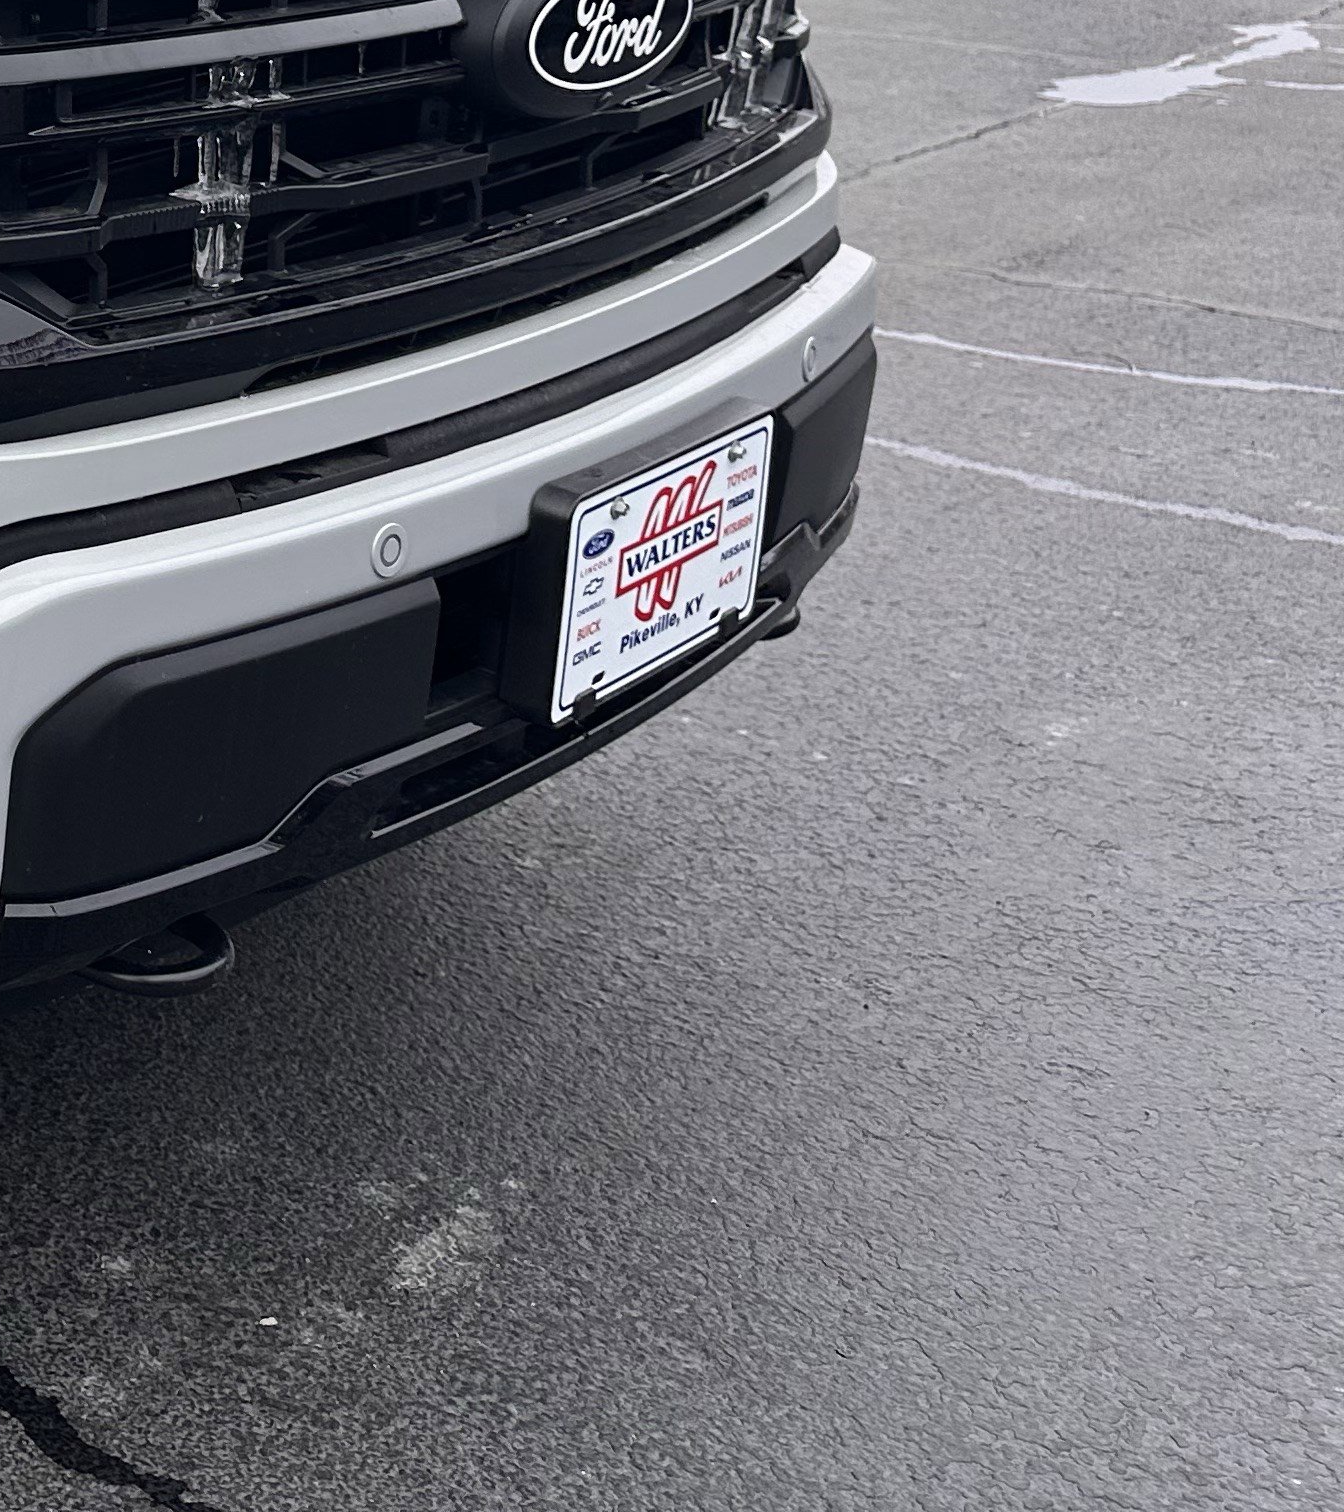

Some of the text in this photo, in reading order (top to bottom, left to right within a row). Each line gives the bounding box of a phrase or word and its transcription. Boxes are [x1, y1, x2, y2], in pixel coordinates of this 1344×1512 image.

[727, 464, 757, 489] TOYOTA
[626, 513, 716, 578] WALTERS
[720, 538, 751, 562] NISSAN
[580, 555, 613, 578] LINCOLN
[619, 592, 704, 654] Pikeville, KY
[572, 641, 602, 666] GMC
